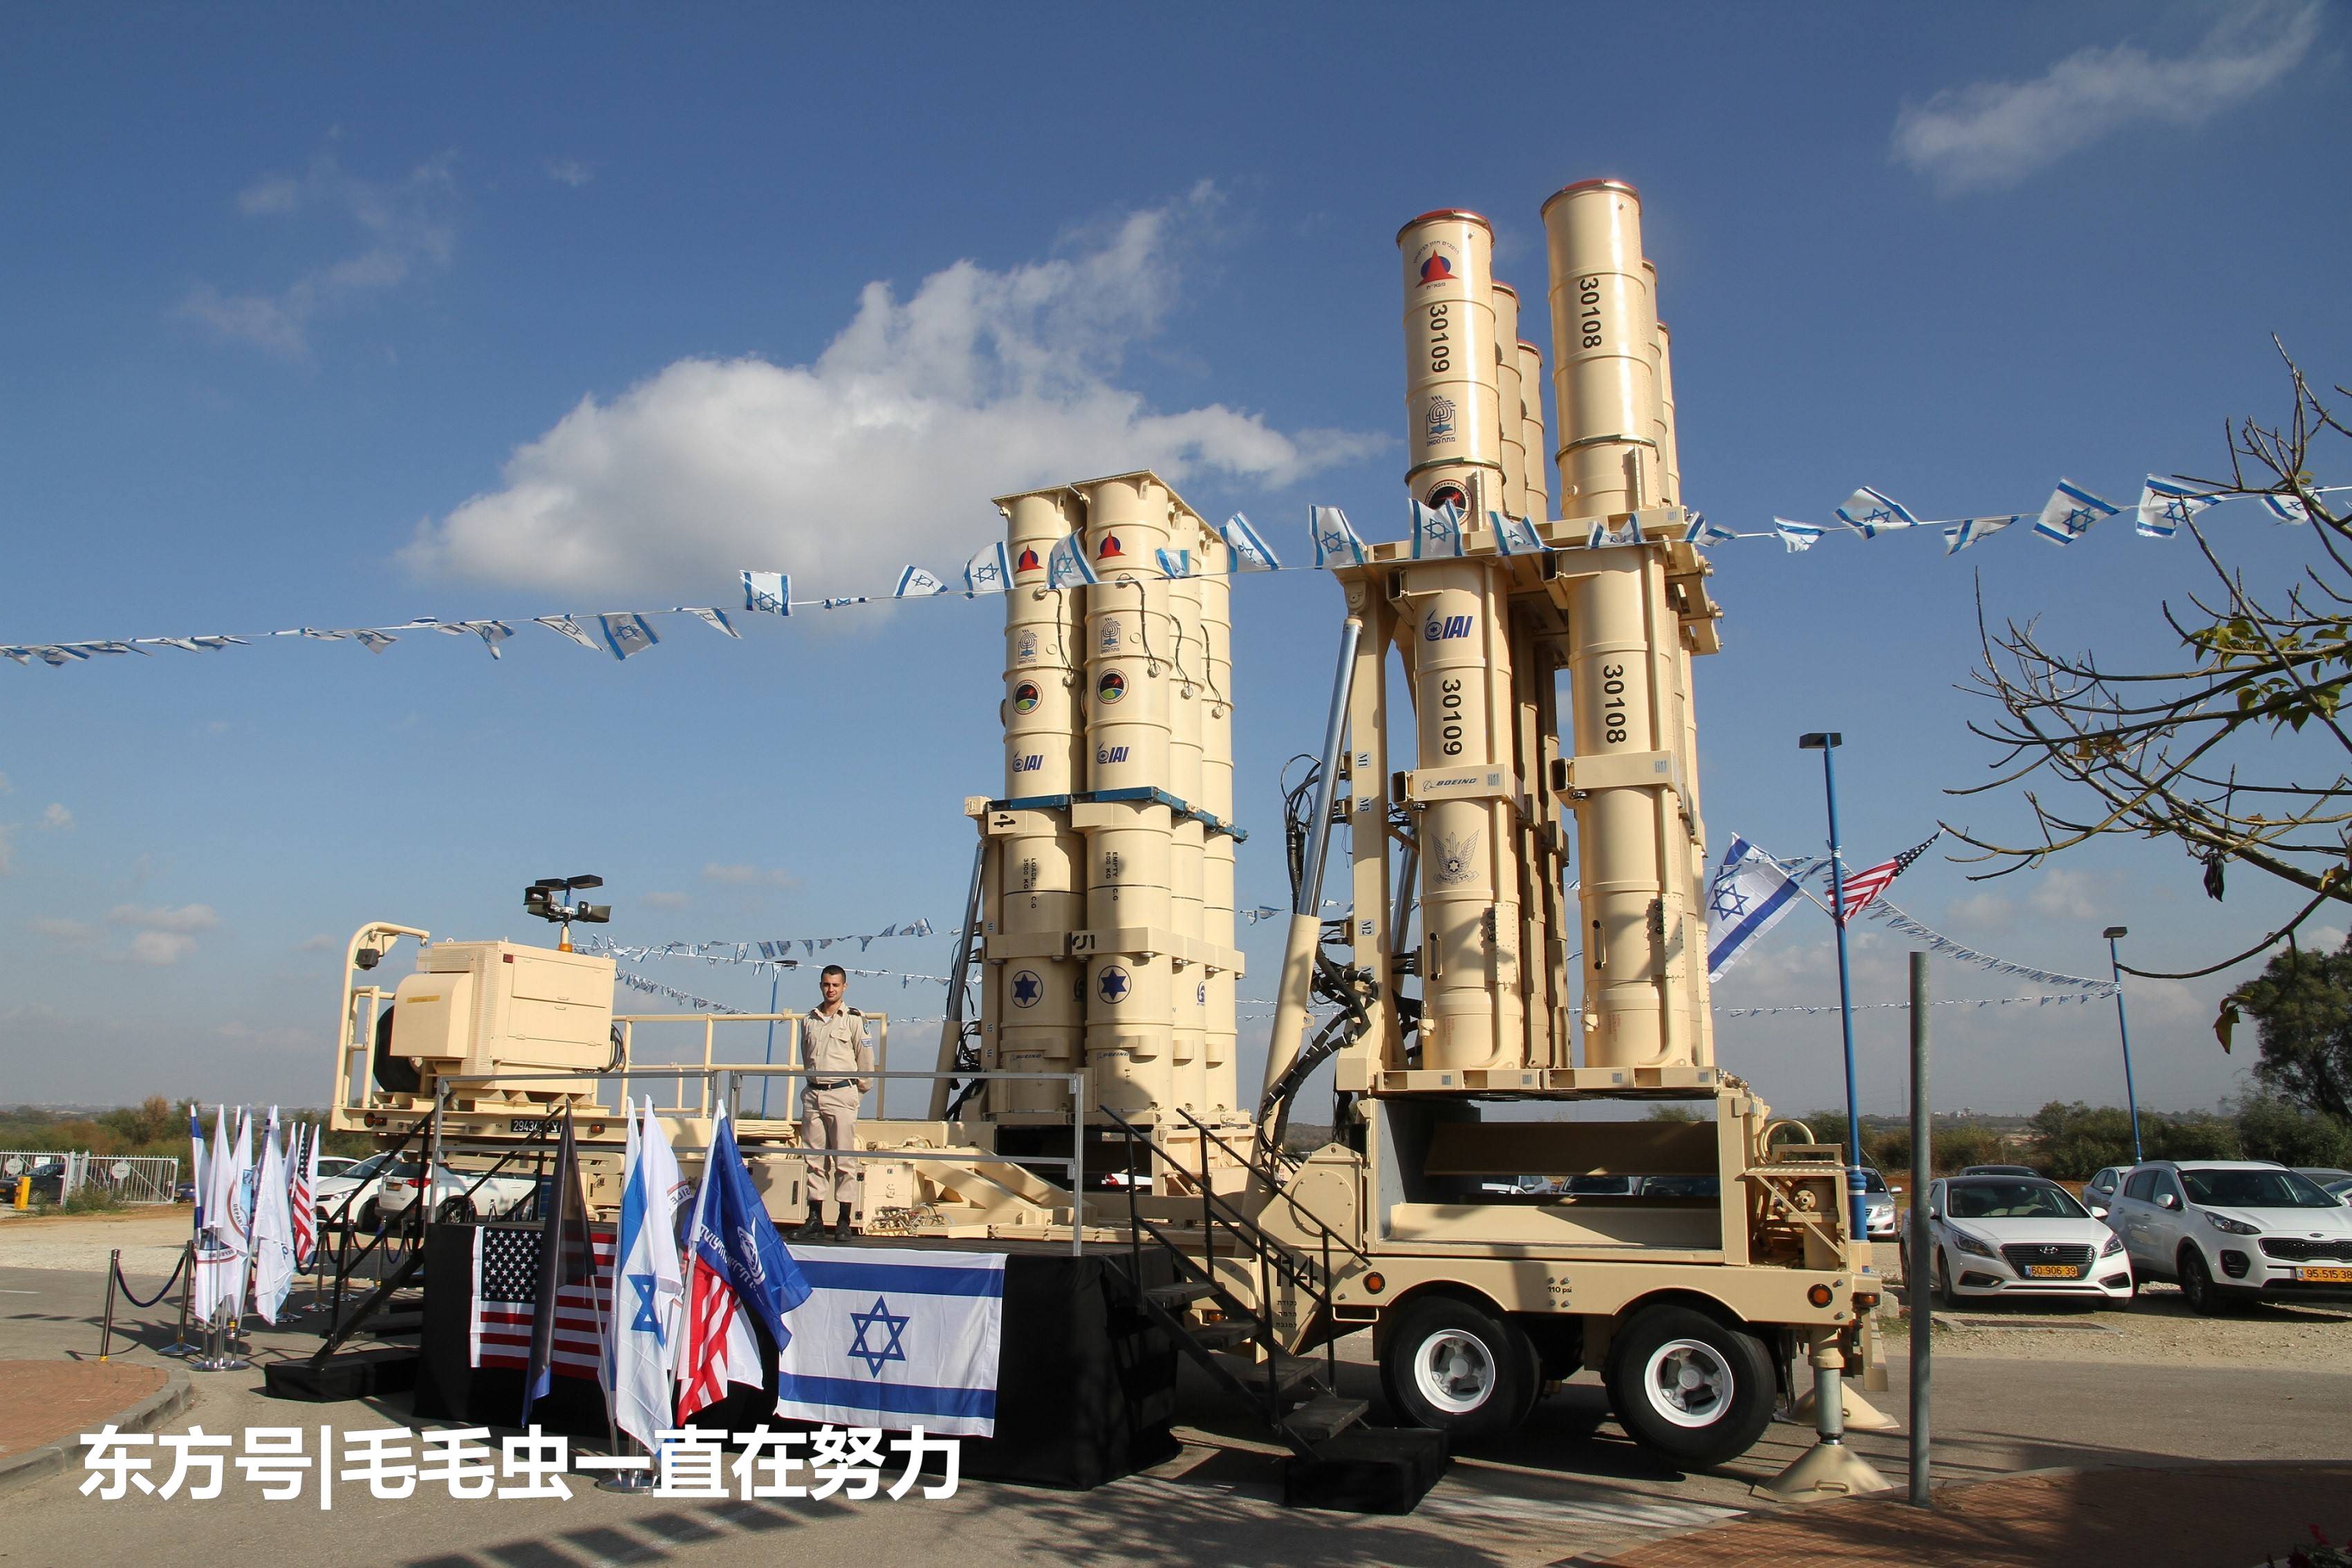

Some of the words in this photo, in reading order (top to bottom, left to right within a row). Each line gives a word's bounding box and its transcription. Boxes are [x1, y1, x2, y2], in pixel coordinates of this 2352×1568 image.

[1580, 278, 1602, 348] 30108
[1430, 304, 1450, 373] 30109
[1442, 616, 1473, 639] IAI
[1603, 664, 1626, 743] 30108
[1441, 679, 1462, 756] 30109
[1108, 747, 1129, 763] IAI
[1358, 754, 1368, 766] M1
[1023, 755, 1043, 772] IAI
[1437, 778, 1477, 786] BOEING
[1359, 798, 1370, 812] M3
[1105, 868, 1111, 879] KG
[1023, 879, 1029, 889] KG
[1361, 921, 1371, 935] M2
